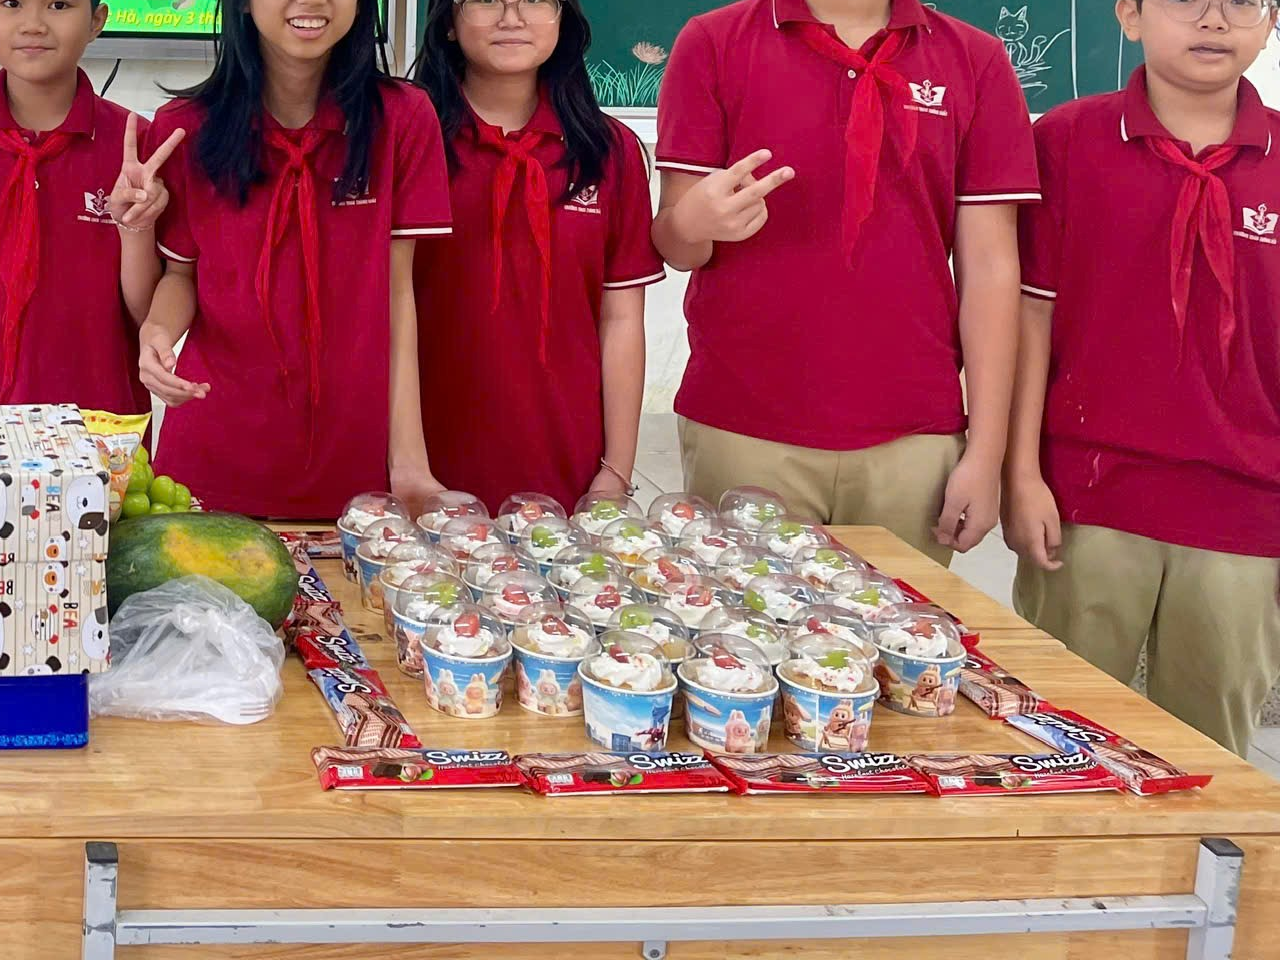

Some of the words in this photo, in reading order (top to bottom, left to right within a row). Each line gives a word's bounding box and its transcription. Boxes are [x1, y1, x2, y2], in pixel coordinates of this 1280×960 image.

[186, 11, 195, 25] 3
[426, 751, 508, 765] Swizz
[629, 753, 708, 770] Swizz
[822, 753, 901, 773] Swizz
[1012, 753, 1090, 772] Swizz
